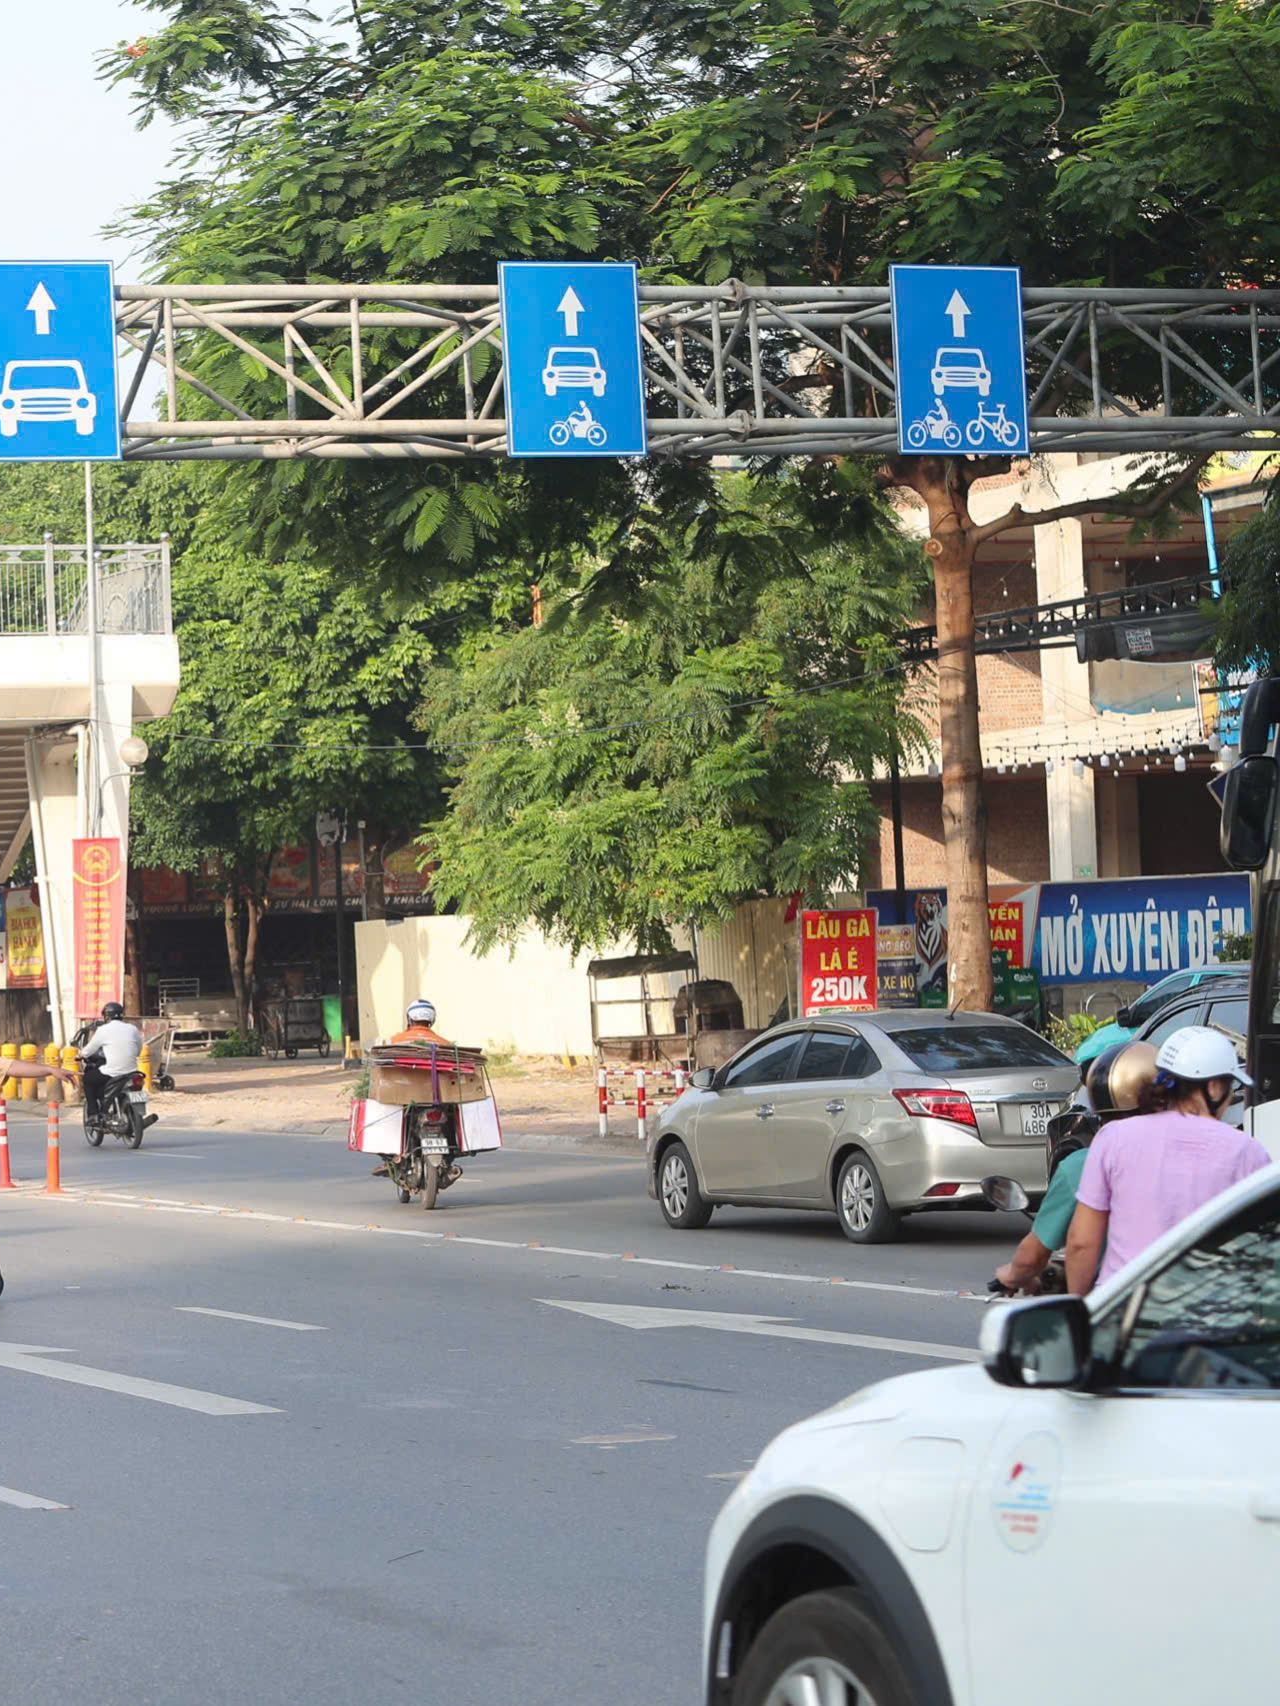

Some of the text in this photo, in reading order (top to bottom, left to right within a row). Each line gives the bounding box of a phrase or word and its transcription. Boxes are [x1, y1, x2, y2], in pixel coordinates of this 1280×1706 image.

[846, 913, 870, 937] GÀ
[1040, 894, 1083, 977] MỞ
[1091, 898, 1180, 974] XUYÊN
[820, 946, 859, 971] LÁ É
[811, 975, 868, 1003] 250K
[883, 975, 897, 989] XE
[1030, 1103, 1052, 1119] 30A
[1024, 1120, 1046, 1134] 486
